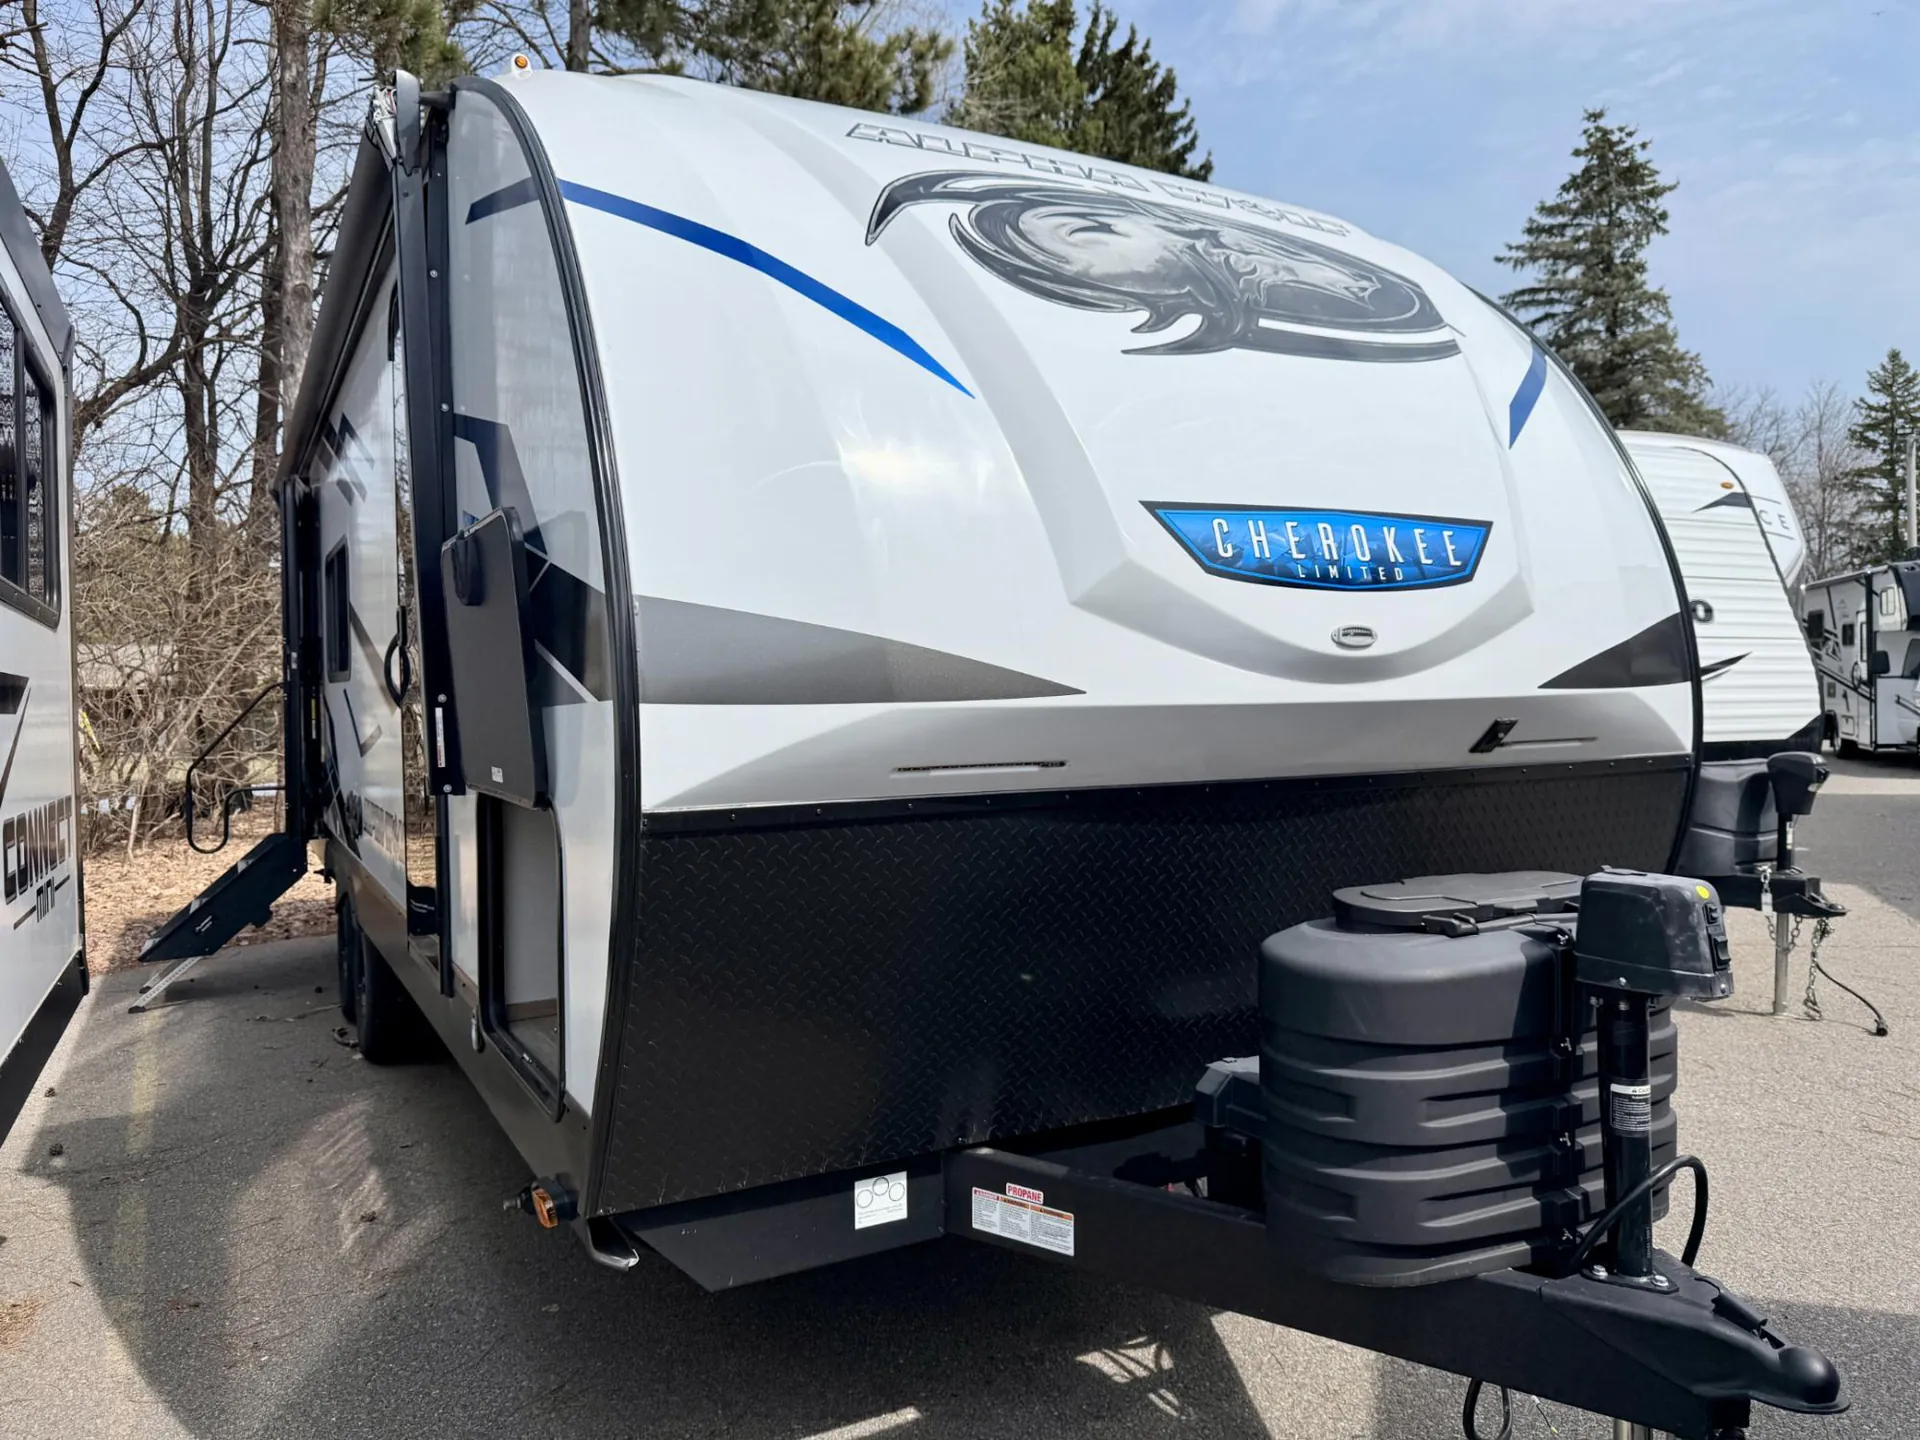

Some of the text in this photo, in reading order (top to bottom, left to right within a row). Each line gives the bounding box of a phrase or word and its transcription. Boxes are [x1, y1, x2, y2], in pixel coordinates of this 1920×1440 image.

[845, 123, 1350, 237] ALPHA WOLF
[1212, 518, 1462, 566] CHEROKEE
[1297, 565, 1404, 581] LIMITED
[3, 795, 72, 905] CONNECT
[1007, 1185, 1042, 1202] PROPANE
